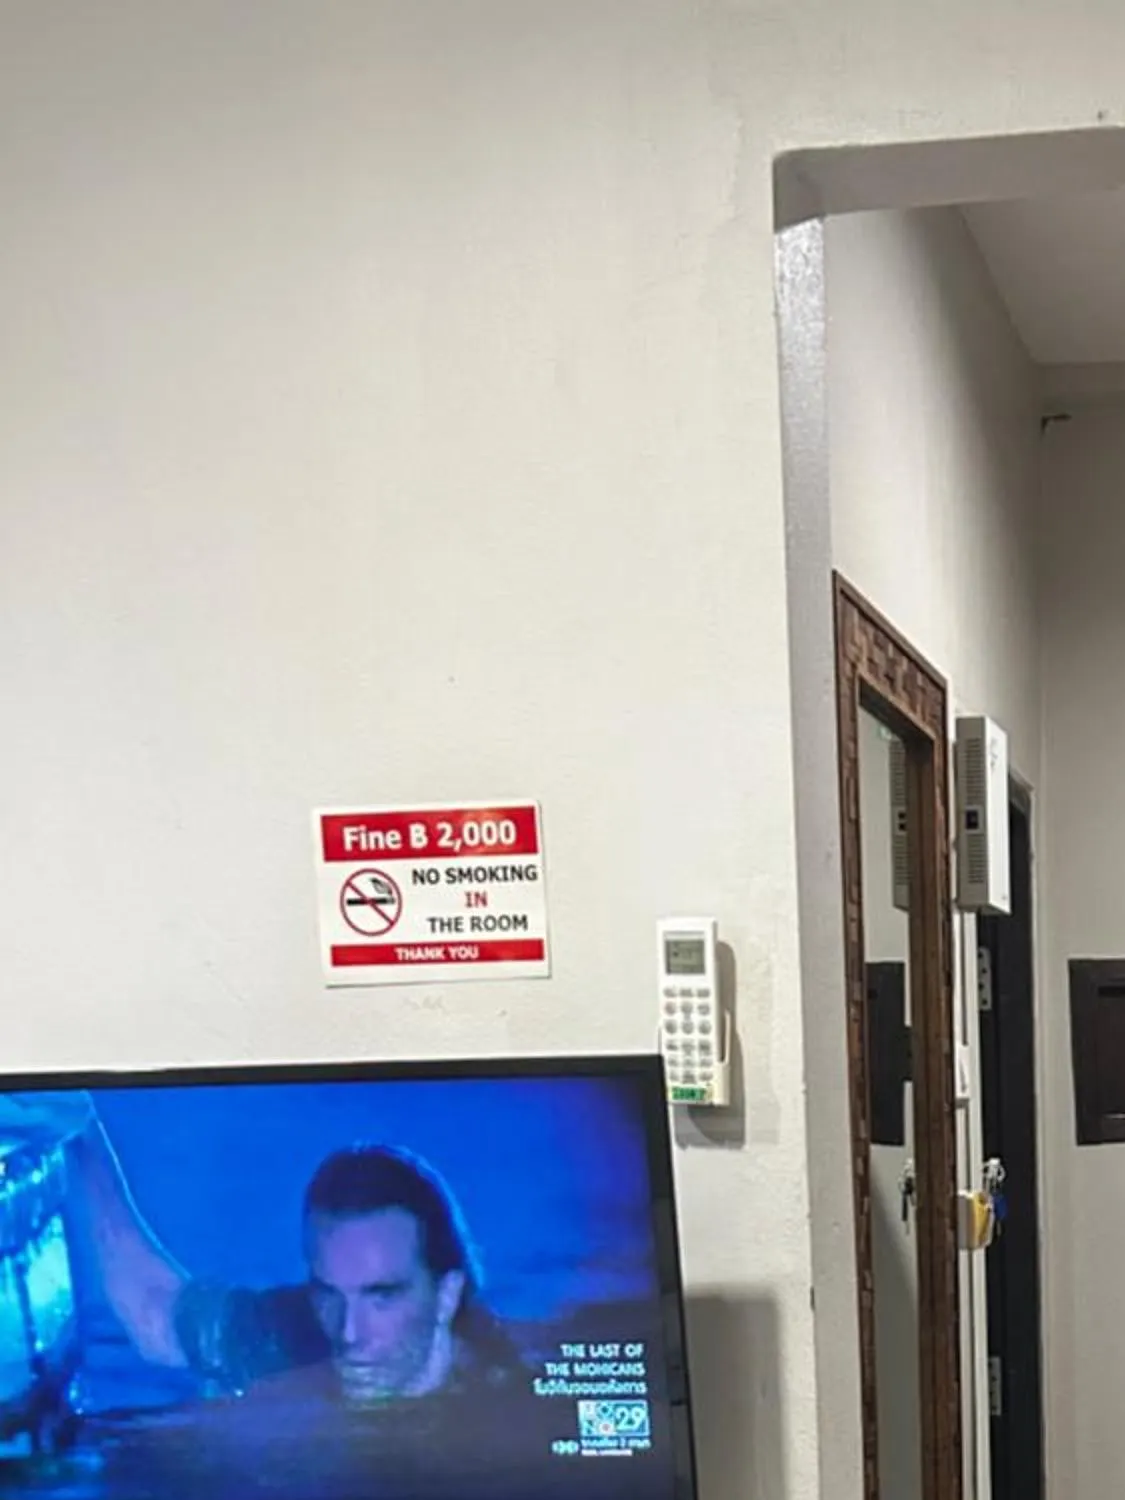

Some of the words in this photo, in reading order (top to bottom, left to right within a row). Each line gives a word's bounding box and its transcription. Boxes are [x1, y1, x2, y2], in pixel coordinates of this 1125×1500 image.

[343, 824, 401, 851] Fine
[437, 820, 516, 852] 2,000
[412, 868, 440, 885] NO
[445, 865, 538, 884] SMOKING
[465, 892, 488, 908] IN
[427, 916, 464, 933] THE
[470, 915, 528, 932] ROOM
[394, 946, 445, 961] THANK
[448, 946, 479, 960] YOU
[560, 1343, 586, 1357] THE
[589, 1343, 620, 1357] LAST
[624, 1343, 645, 1357] OF
[545, 1362, 570, 1377] THE
[616, 1407, 645, 1432] 29
